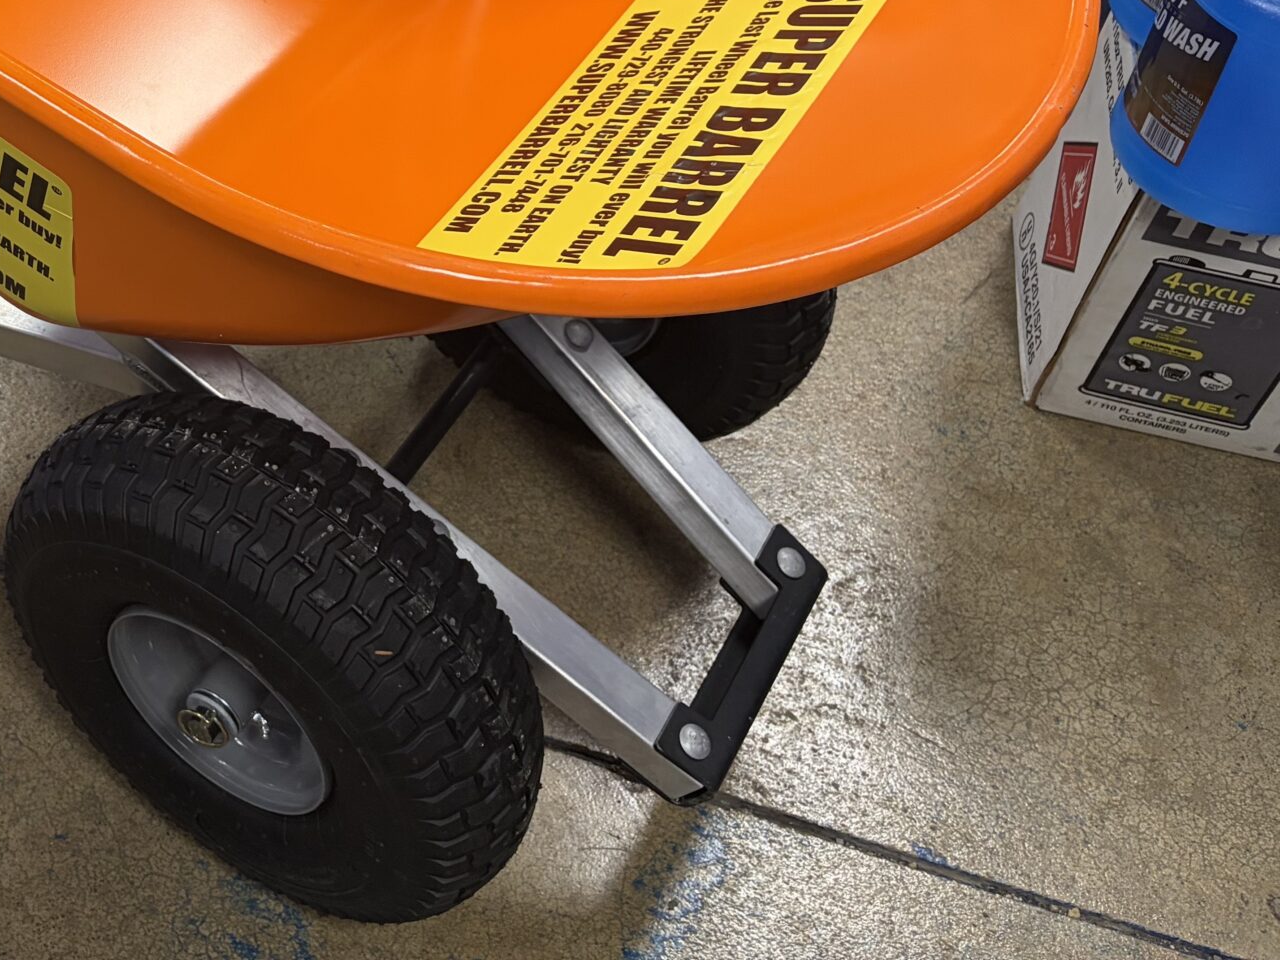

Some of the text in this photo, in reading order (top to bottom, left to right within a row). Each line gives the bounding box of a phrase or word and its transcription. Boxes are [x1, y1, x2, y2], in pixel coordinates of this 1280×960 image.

[739, 11, 780, 38] Last
[1163, 16, 1220, 62] WASH
[639, 15, 715, 87] STRONGEST
[704, 40, 758, 84] Wheel
[443, 10, 661, 233] WWW.SUPERBARRELL.COM
[501, 27, 675, 214] 440-729-8080 216-701-7448
[590, 50, 718, 185] LIFETIME WARRANTY
[615, 88, 653, 116] AND
[671, 86, 721, 130] Barrel
[560, 118, 630, 182] LIGHTEST
[643, 132, 680, 159] you
[539, 184, 574, 204] ON
[602, 106, 787, 257] BARREL
[618, 162, 656, 190] will
[589, 192, 630, 227] ever
[18, 210, 63, 249] buy!
[494, 207, 555, 256] EARTH.
[556, 230, 605, 265] buy!
[1154, 288, 1247, 316] ENGINEERED
[1162, 272, 1256, 307] 4-CYCLE
[1147, 299, 1216, 325] FUEL
[1104, 378, 1236, 418] TRUFUEL
[1118, 414, 1187, 435] CONTAINERS
